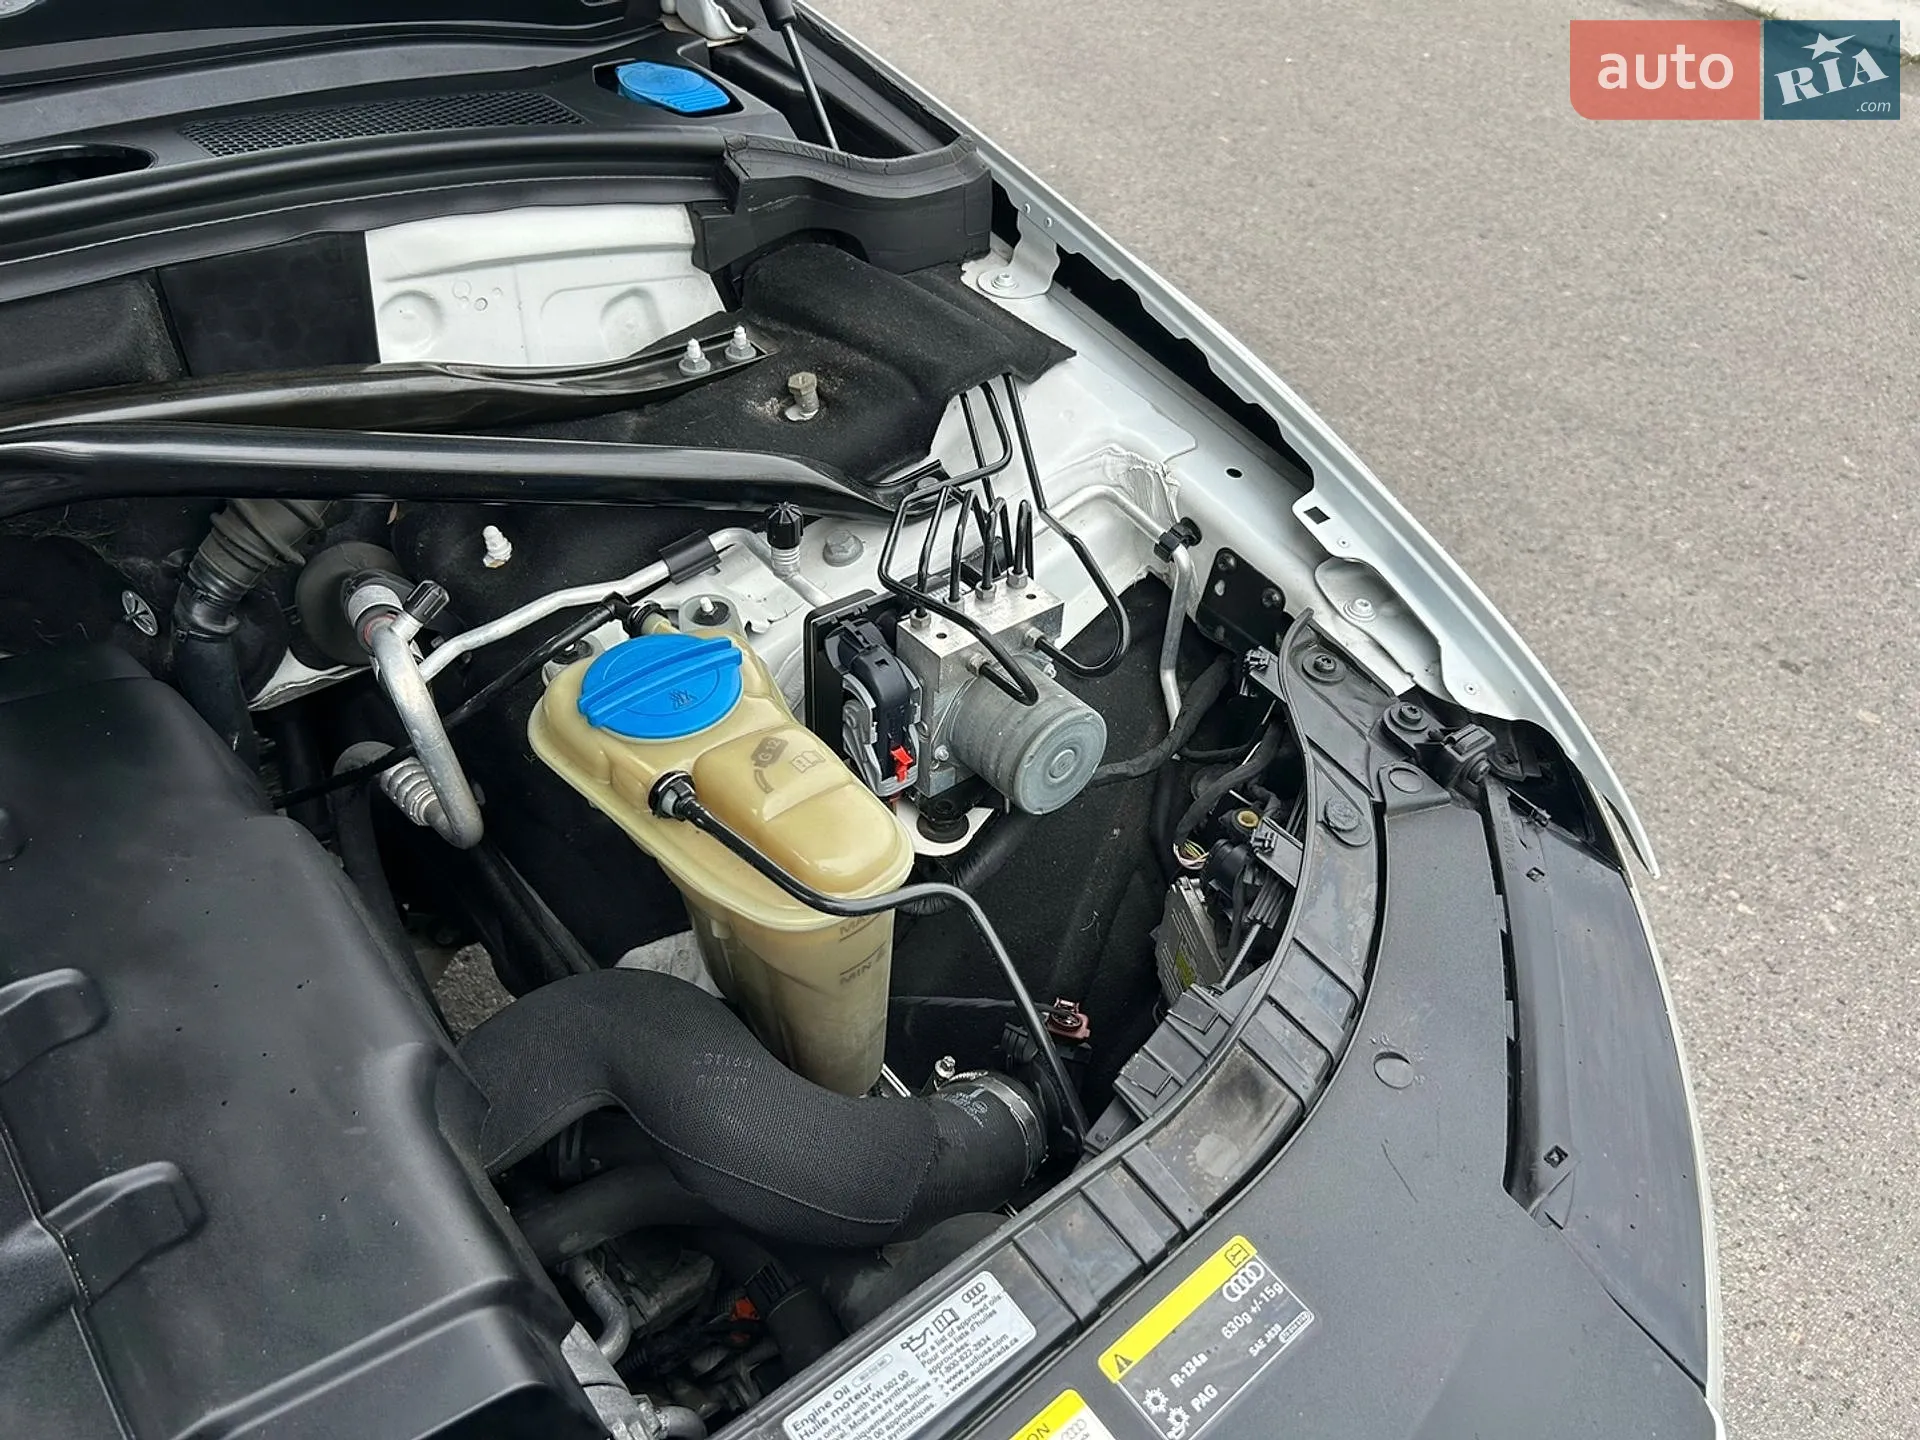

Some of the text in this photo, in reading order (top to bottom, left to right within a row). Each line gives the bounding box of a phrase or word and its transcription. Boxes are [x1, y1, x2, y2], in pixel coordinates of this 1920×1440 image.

[915, 1348, 930, 1361] For
[947, 1326, 956, 1338] of
[955, 1304, 989, 1332] approved
[1221, 1311, 1253, 1339] 630g
[921, 1352, 940, 1368] Pour
[939, 1342, 954, 1355] une
[1249, 1337, 1267, 1357] SAE
[852, 1401, 870, 1416] with
[868, 1389, 884, 1402] VW
[897, 1370, 909, 1381] 00
[1190, 1384, 1218, 1412] PAG
[792, 1384, 851, 1431] Engine Oil
[798, 1382, 873, 1440] Huile moteur
[848, 1412, 870, 1431] Most
[869, 1403, 883, 1415] are
